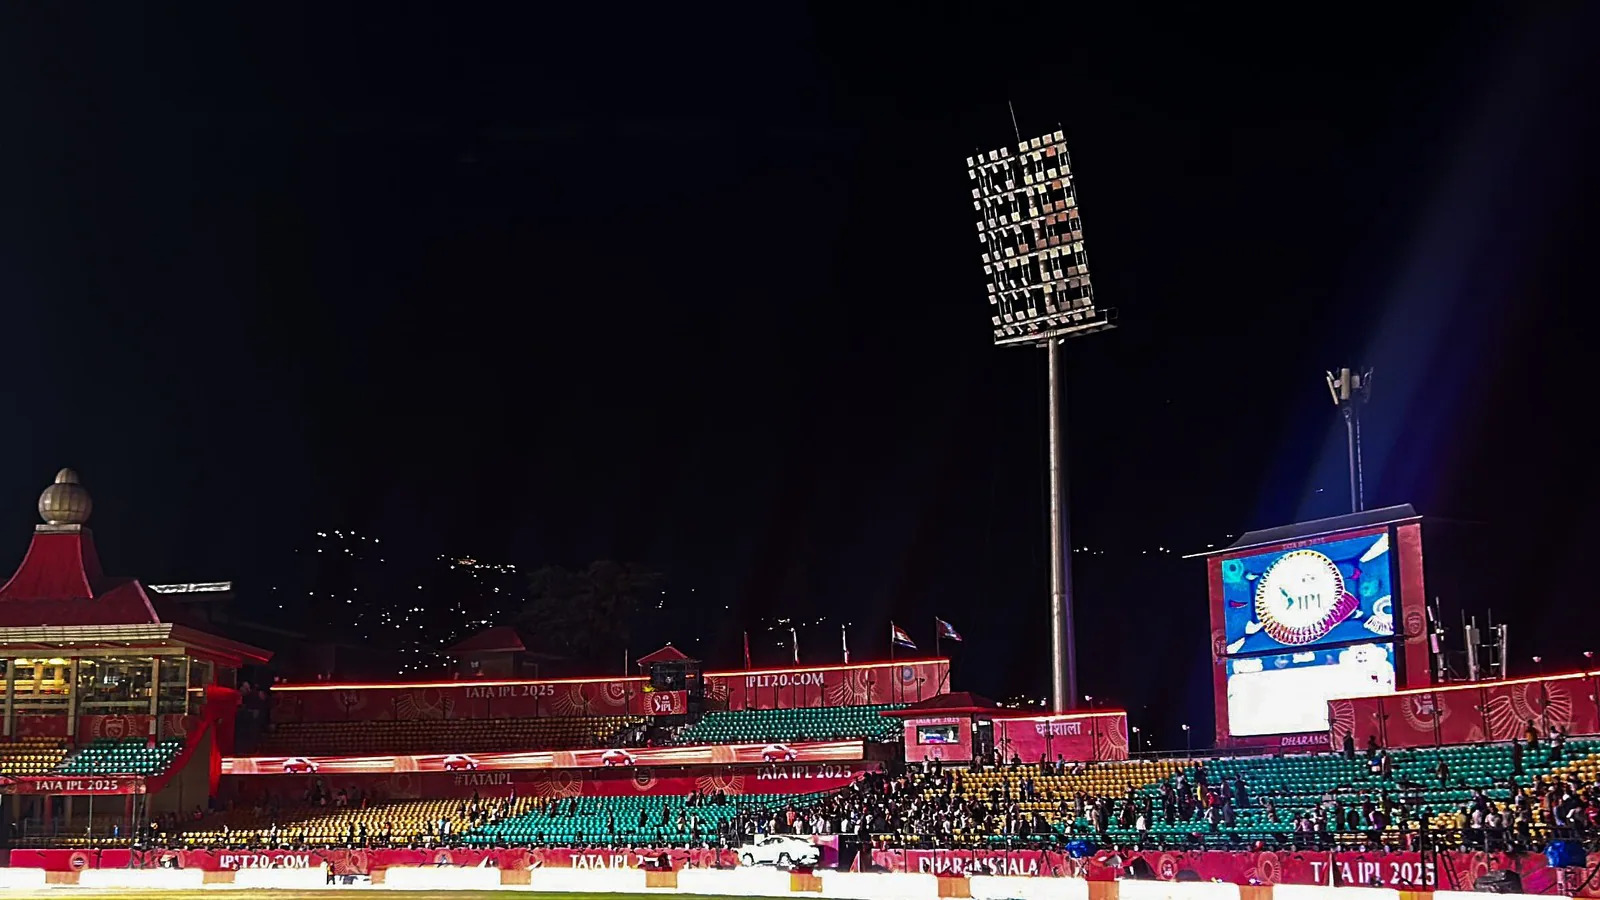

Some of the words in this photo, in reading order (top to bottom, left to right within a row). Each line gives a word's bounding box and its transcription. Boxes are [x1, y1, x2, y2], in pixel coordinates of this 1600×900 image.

[745, 672, 824, 688] IPLT20.COM
[465, 687, 495, 698] TATA
[498, 686, 517, 697] IPL
[522, 684, 554, 697] 2025
[454, 772, 514, 786] #TATAIPL
[755, 766, 789, 780] TATA
[791, 766, 813, 779] IPL
[816, 765, 852, 779] 2025
[35, 780, 63, 790] TATA
[66, 780, 84, 790] IPL
[87, 780, 118, 790] 2025
[219, 854, 310, 869] IPLT20COM
[569, 854, 606, 870] TATA
[1309, 861, 1355, 884] TA
[1389, 861, 1436, 886] 2025
